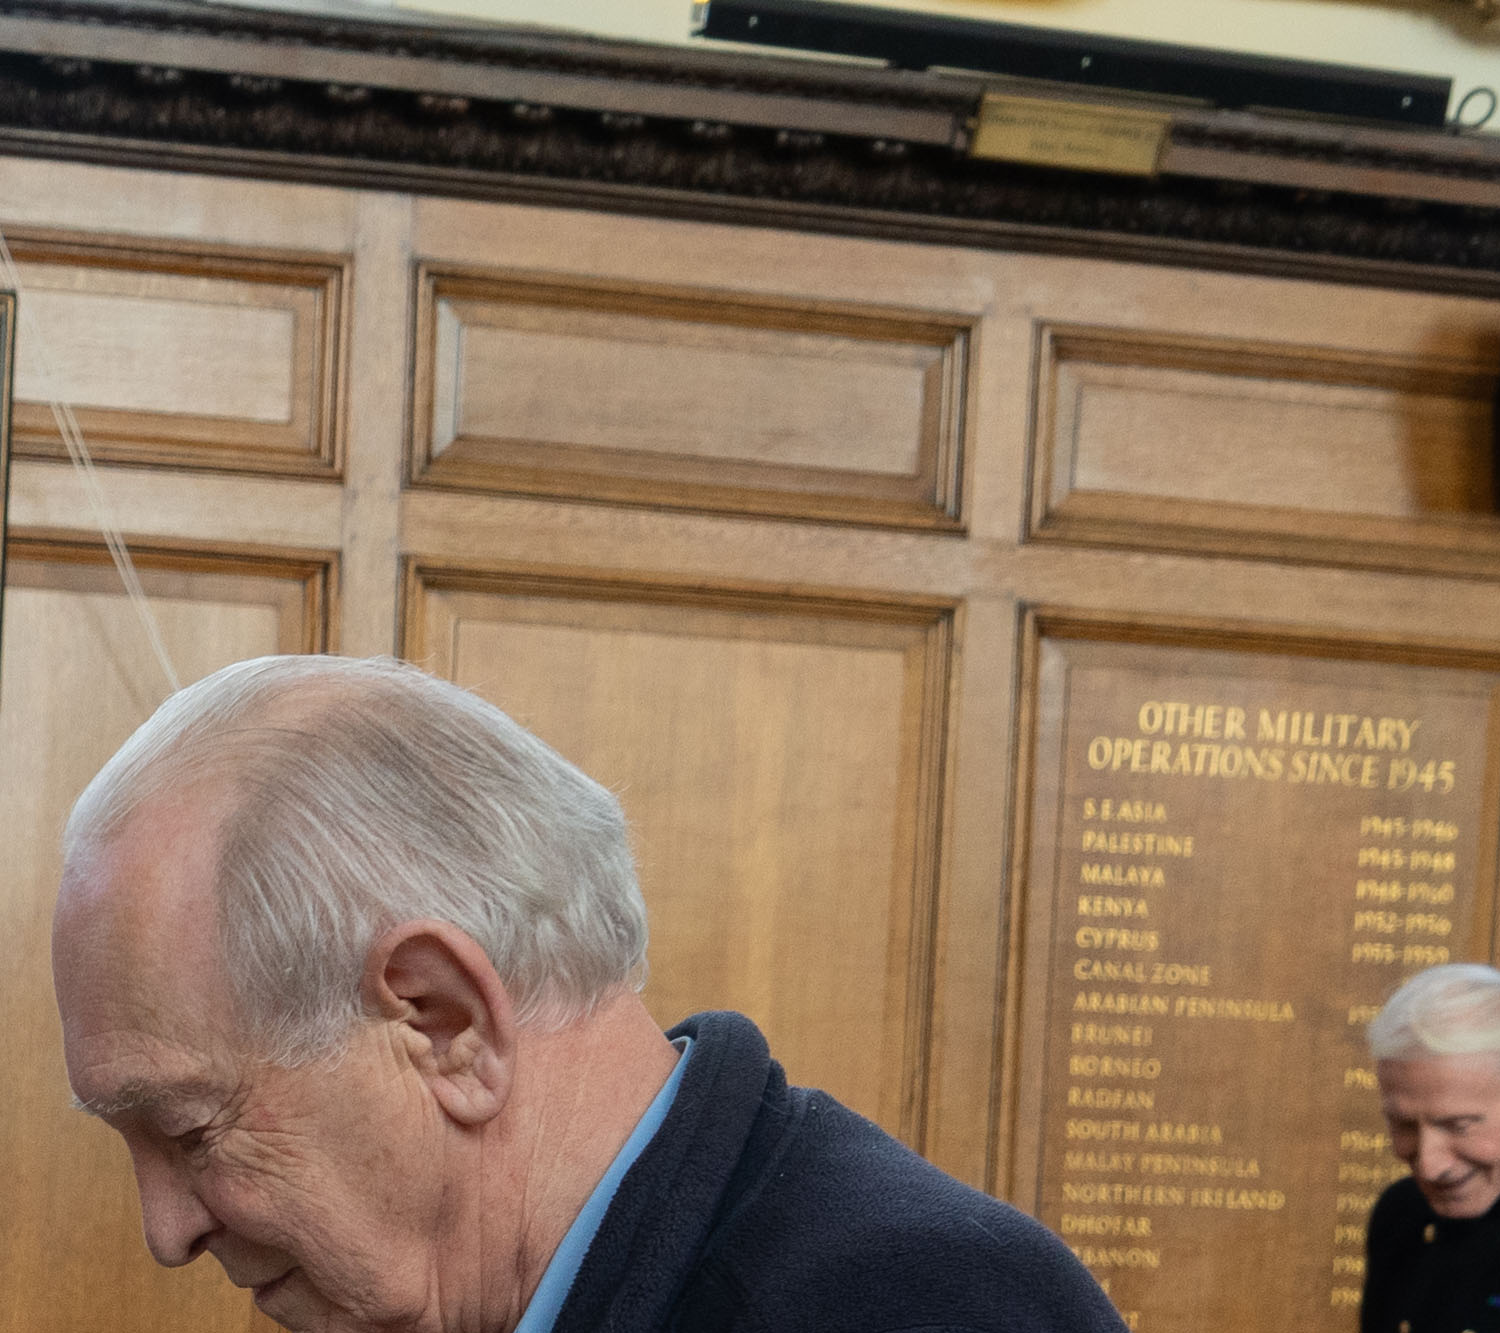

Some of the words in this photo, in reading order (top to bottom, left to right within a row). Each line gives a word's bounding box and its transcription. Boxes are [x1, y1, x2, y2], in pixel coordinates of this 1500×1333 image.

[1139, 700, 1246, 740] OTHER
[1257, 707, 1421, 752] MILITARY
[1088, 735, 1285, 782] OPERATIONS
[1287, 750, 1380, 789] SINCE
[1389, 758, 1457, 794] 1945
[1117, 800, 1167, 823] ASIA
[1082, 830, 1195, 858] PALESTINE
[1080, 863, 1166, 887] MALAYA
[1078, 896, 1149, 919] KENYA
[1075, 926, 1160, 951] CYPRUS
[1073, 959, 1146, 983] CANAL
[1151, 963, 1211, 986] ZONE
[1072, 991, 1169, 1015] ARABIAN
[1174, 996, 1295, 1022] PENINSULA
[1071, 1023, 1153, 1046] BRUNEI
[1069, 1055, 1162, 1079] BORNEO
[1066, 1119, 1139, 1141] SOUTH
[1145, 1122, 1223, 1145] ARABIA
[1062, 1182, 1185, 1207] NORTHERN
[1191, 1188, 1286, 1210] IRELAND
